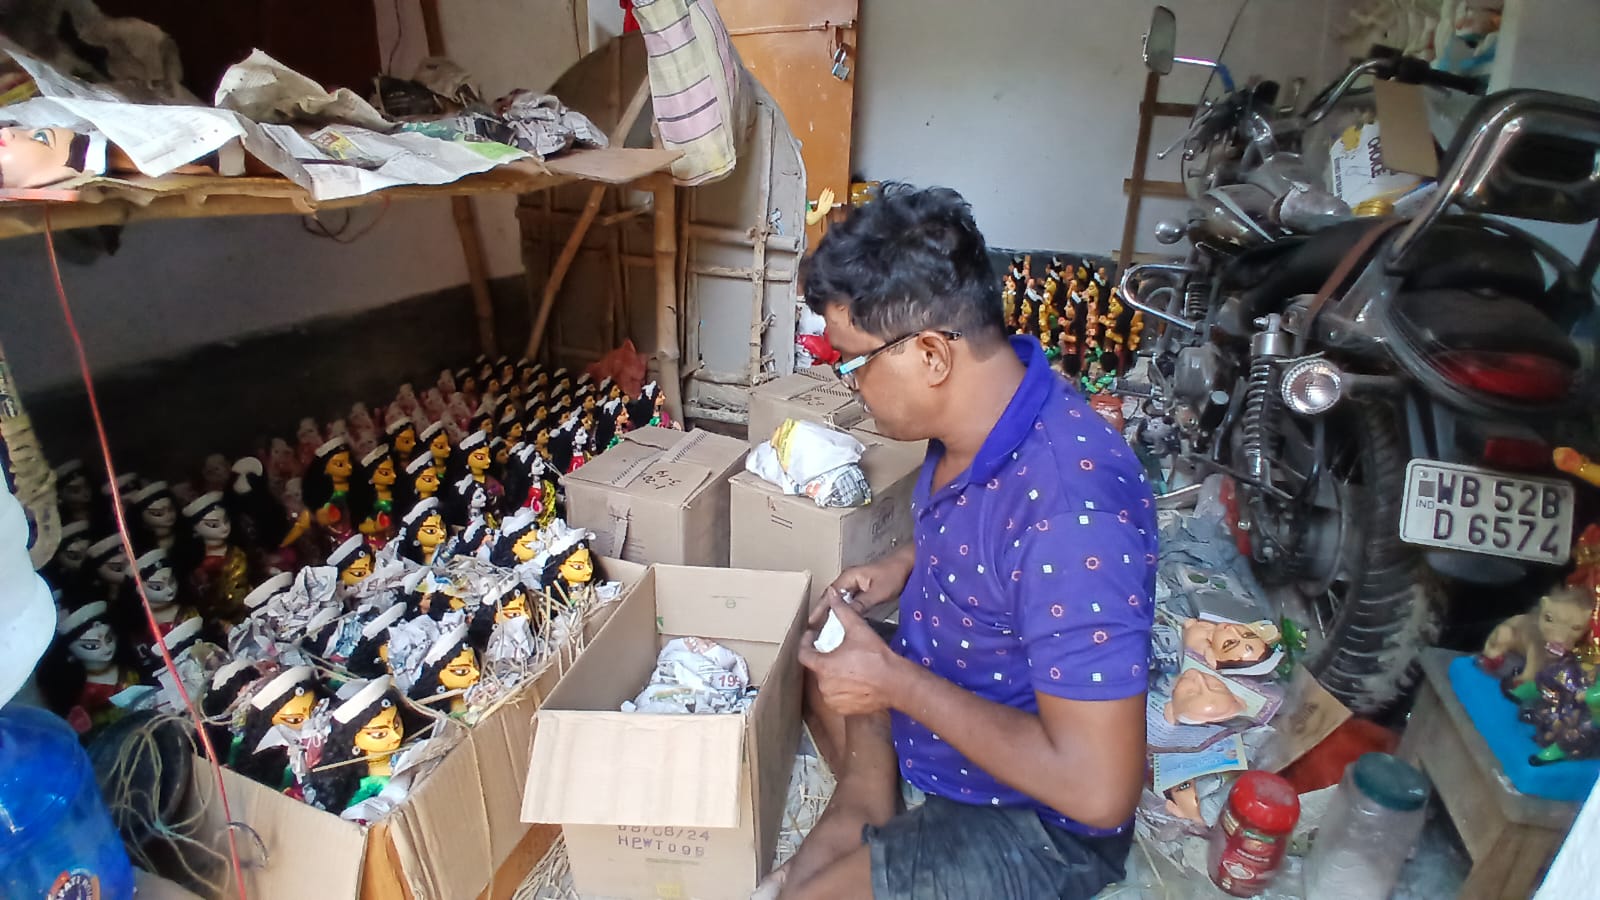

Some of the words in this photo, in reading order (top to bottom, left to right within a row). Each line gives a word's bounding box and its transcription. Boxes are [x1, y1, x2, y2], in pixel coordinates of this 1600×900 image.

[1415, 498, 1435, 510] IND
[1437, 472, 1480, 508] WB
[1494, 481, 1560, 519] 52B
[1433, 508, 1454, 540] D
[1468, 513, 1559, 557] 6574
